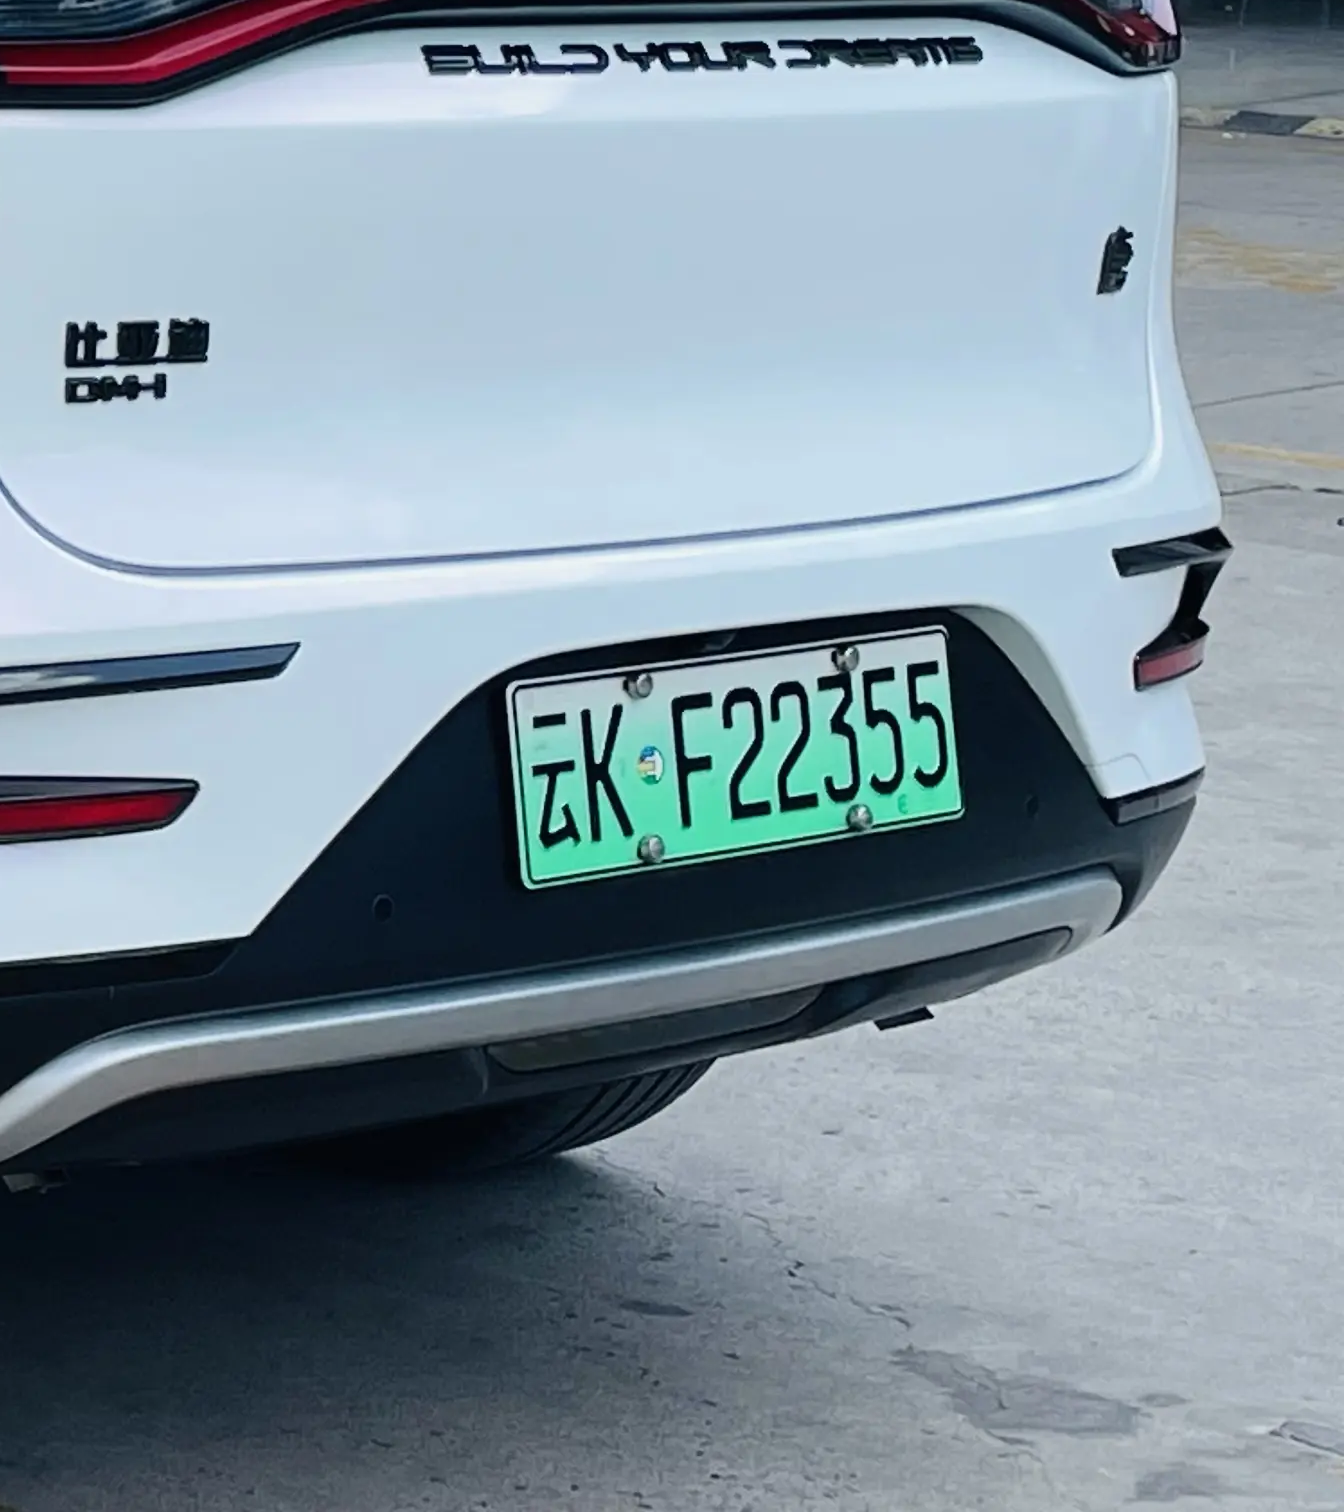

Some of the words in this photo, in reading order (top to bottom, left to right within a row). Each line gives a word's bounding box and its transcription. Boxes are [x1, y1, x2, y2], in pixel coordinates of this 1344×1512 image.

[419, 43, 610, 76] BUILD
[613, 40, 776, 72] YOUR
[777, 35, 984, 70] DREAMS
[64, 317, 210, 368] 比亚迪
